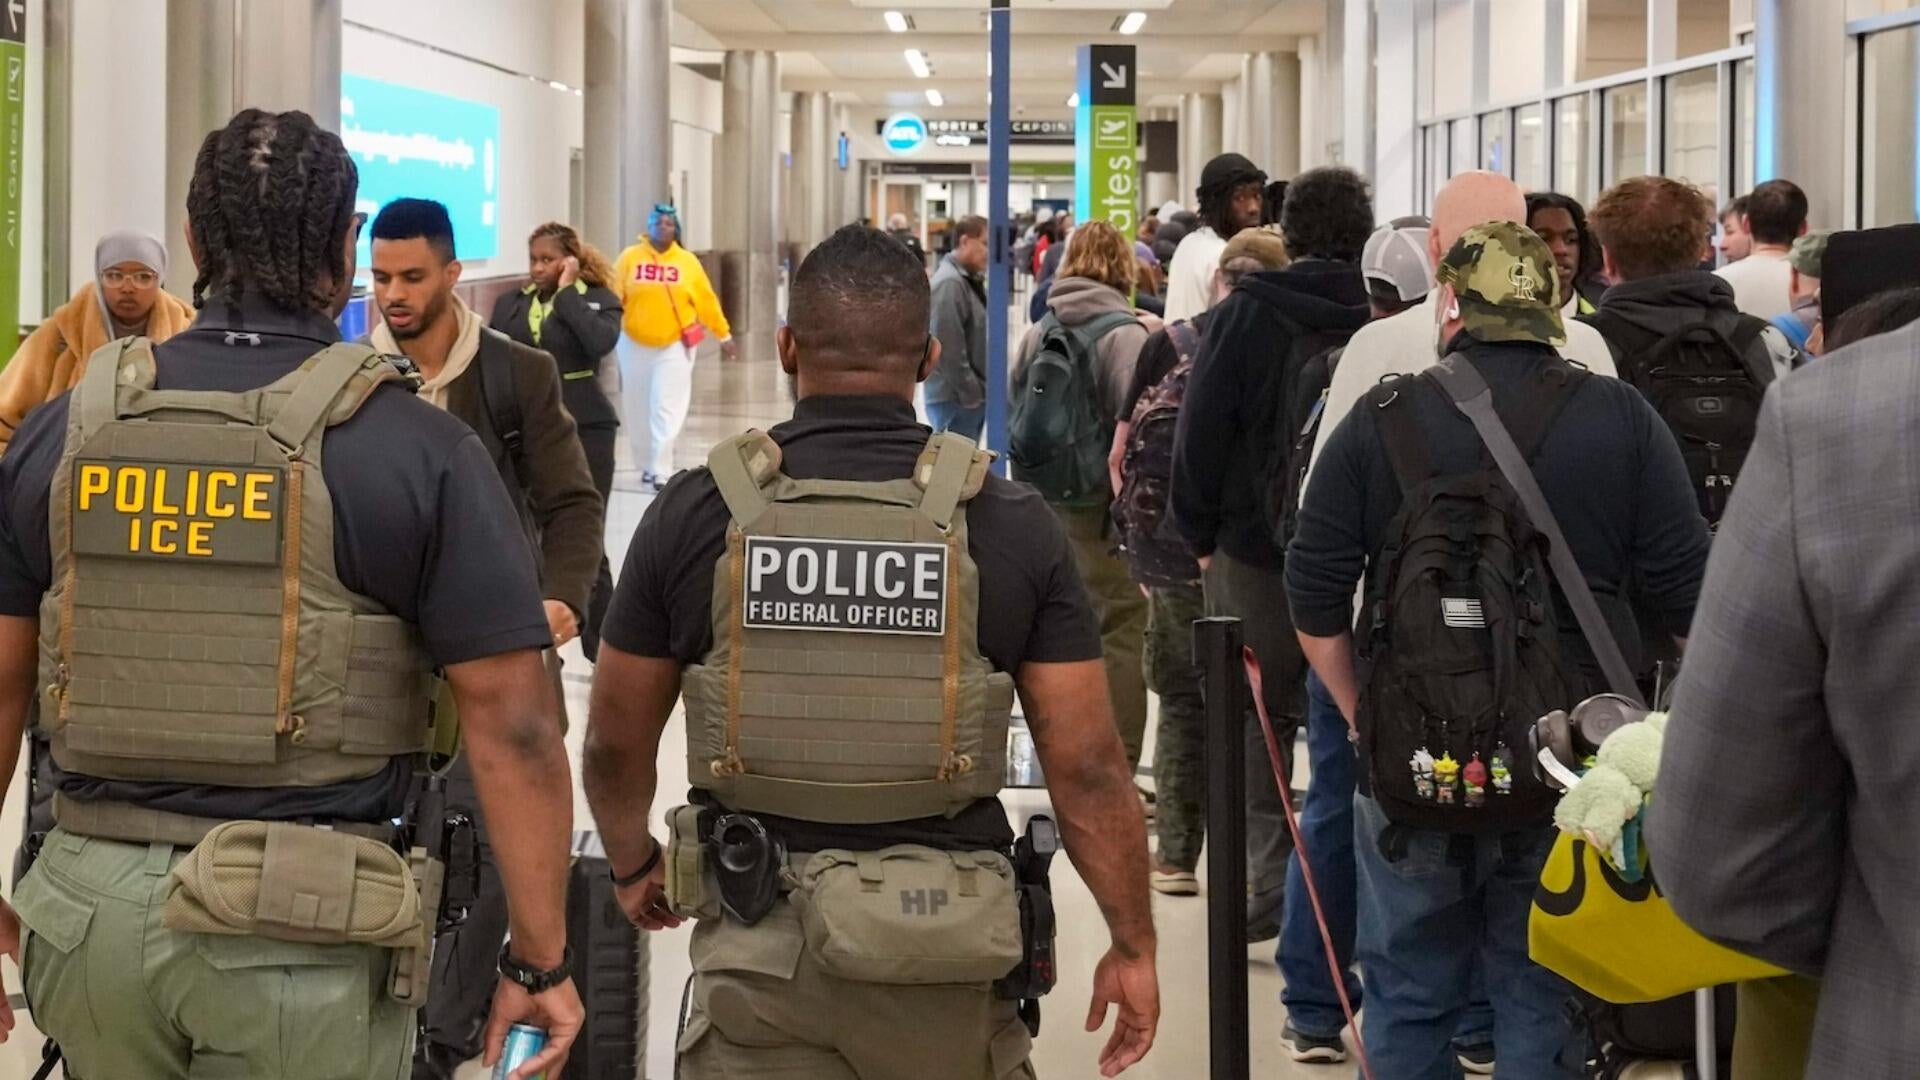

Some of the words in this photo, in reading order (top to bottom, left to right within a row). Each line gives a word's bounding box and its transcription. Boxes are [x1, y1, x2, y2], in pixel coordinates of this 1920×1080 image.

[928, 120, 979, 132] NORTH
[1102, 155, 1132, 232] ates
[7, 209, 16, 248] All
[634, 263, 680, 283] 1913
[79, 464, 274, 520] POLICE
[129, 518, 215, 556] ICE
[751, 546, 941, 600] POLICE
[749, 600, 840, 624] FEDERAL
[847, 604, 938, 628] OFFICER
[900, 888, 948, 916] HP
